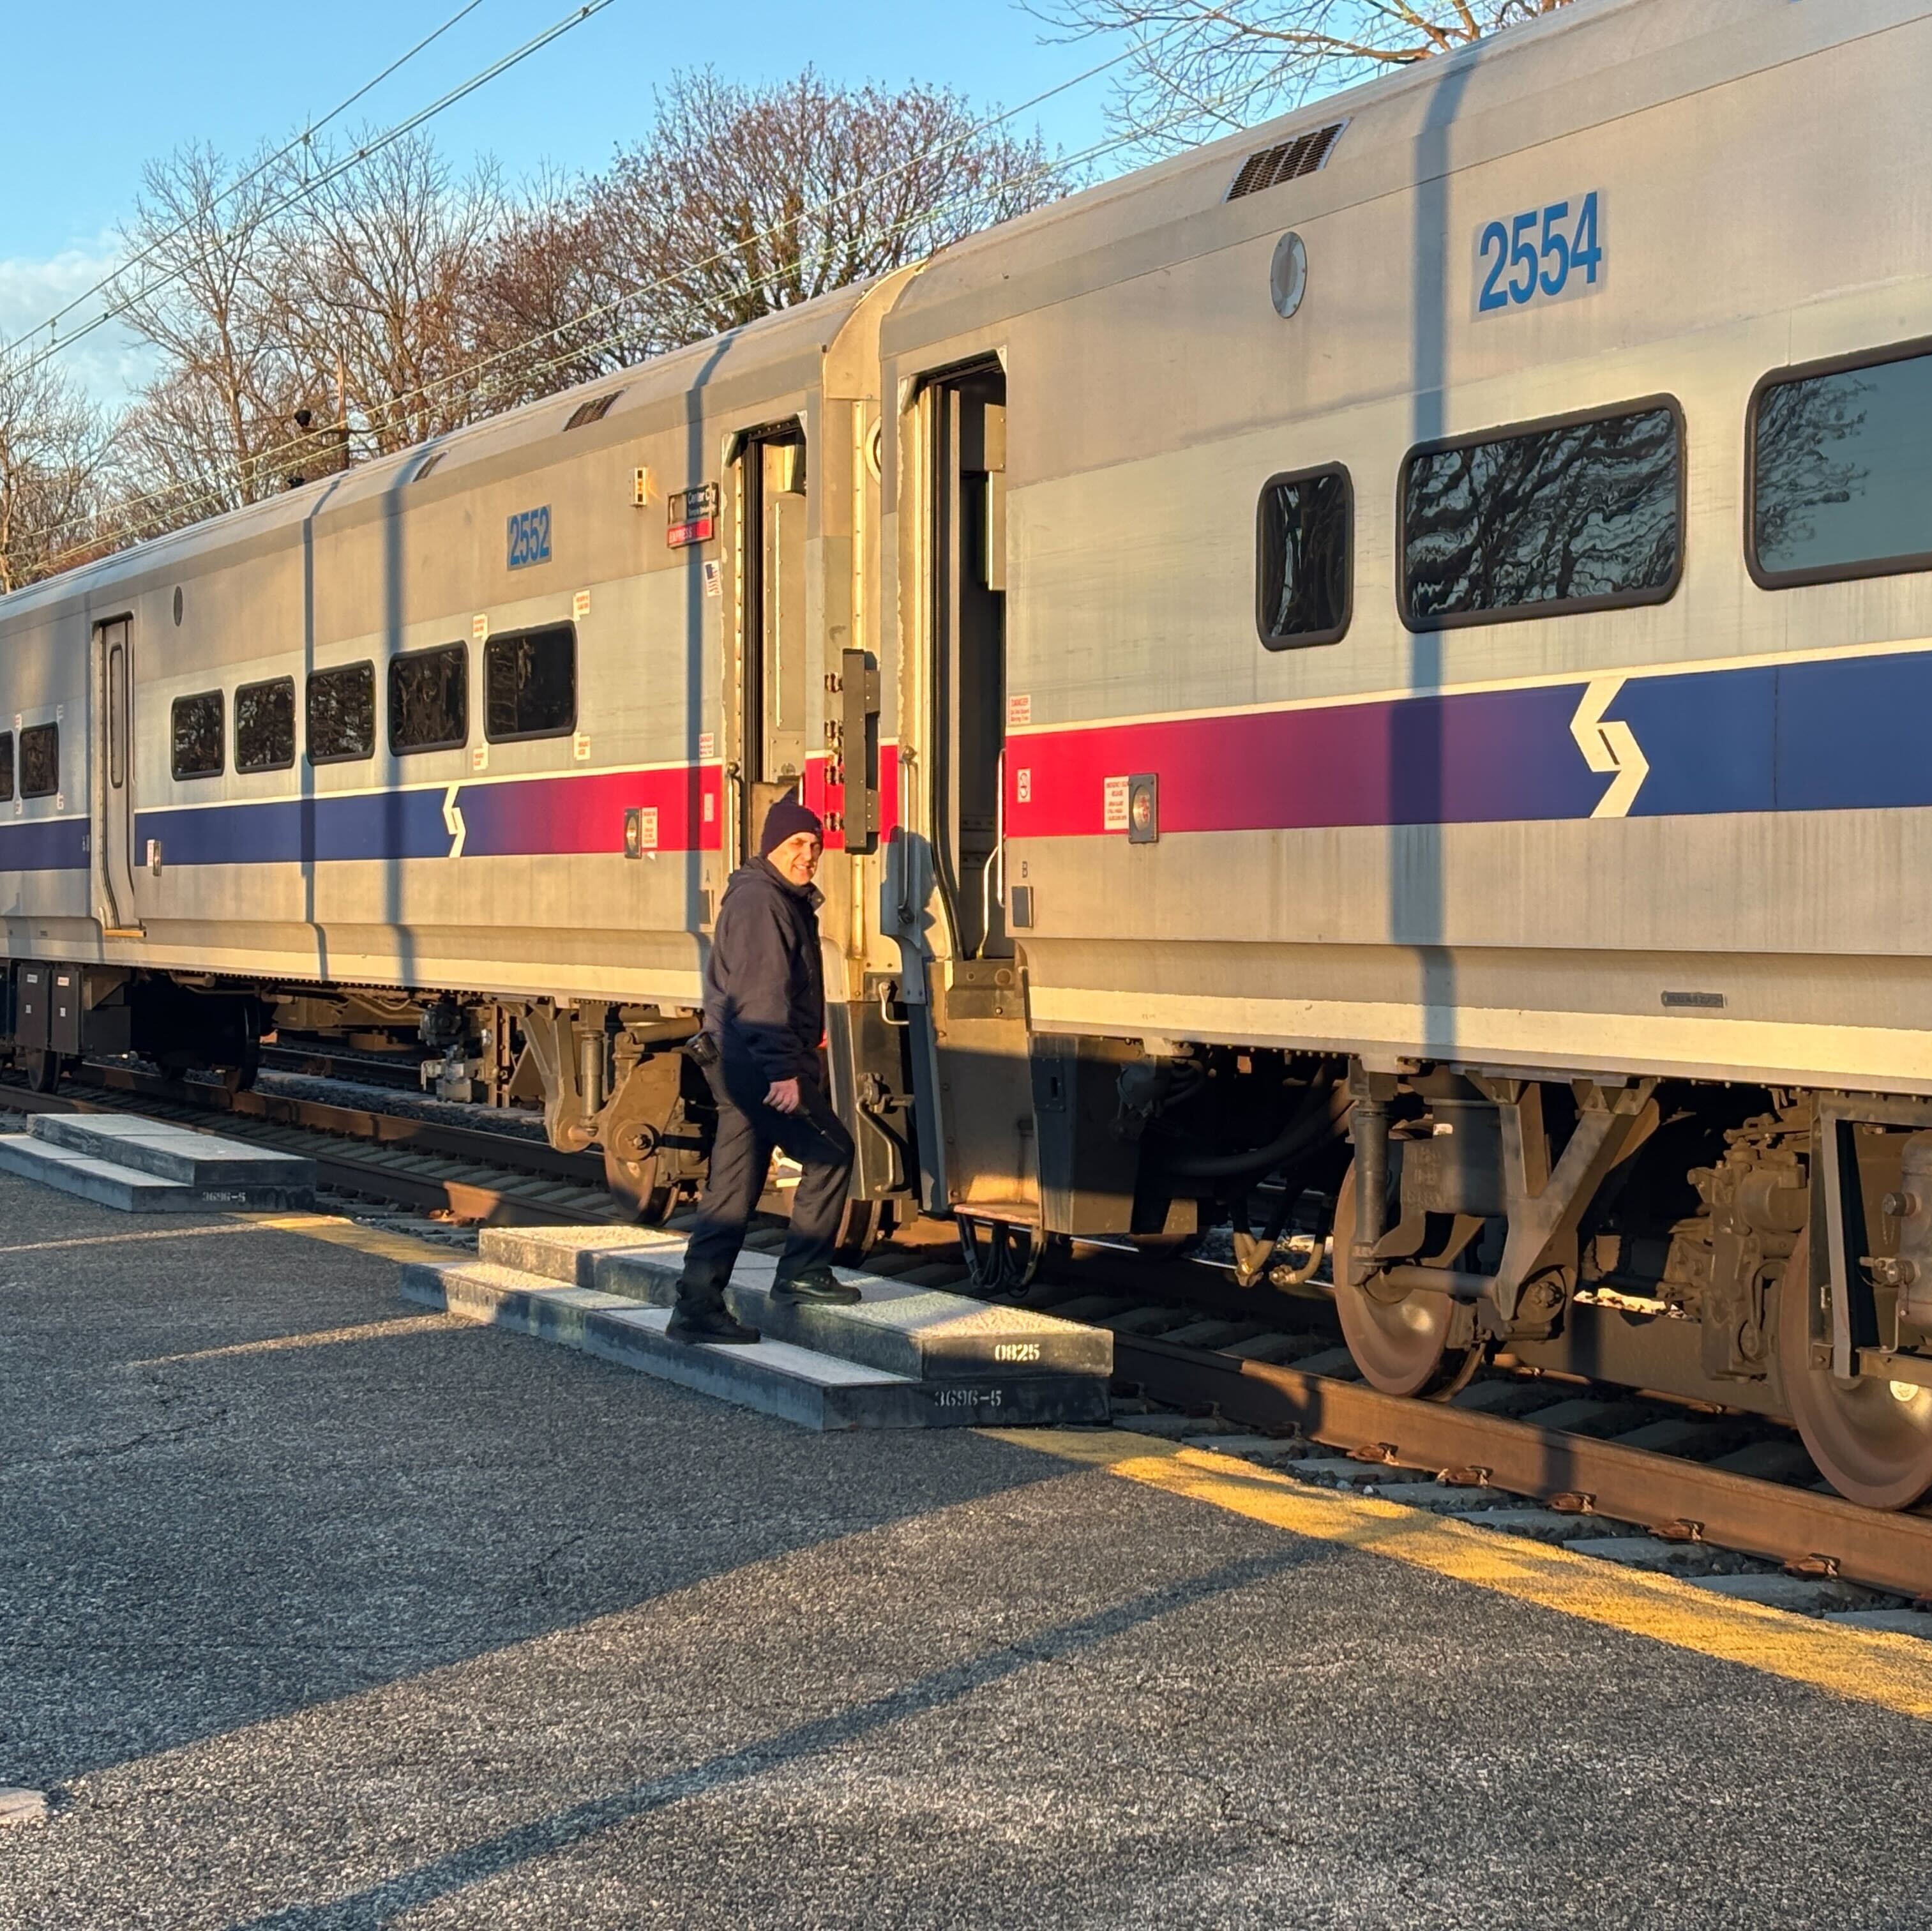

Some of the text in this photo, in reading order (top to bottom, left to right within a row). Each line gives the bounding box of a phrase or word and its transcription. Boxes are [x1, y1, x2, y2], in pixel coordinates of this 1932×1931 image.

[1479, 191, 1602, 312] 2554
[510, 506, 550, 566] 2552
[994, 1344, 1041, 1361] 0825
[934, 1390, 1002, 1407] 3696-5
